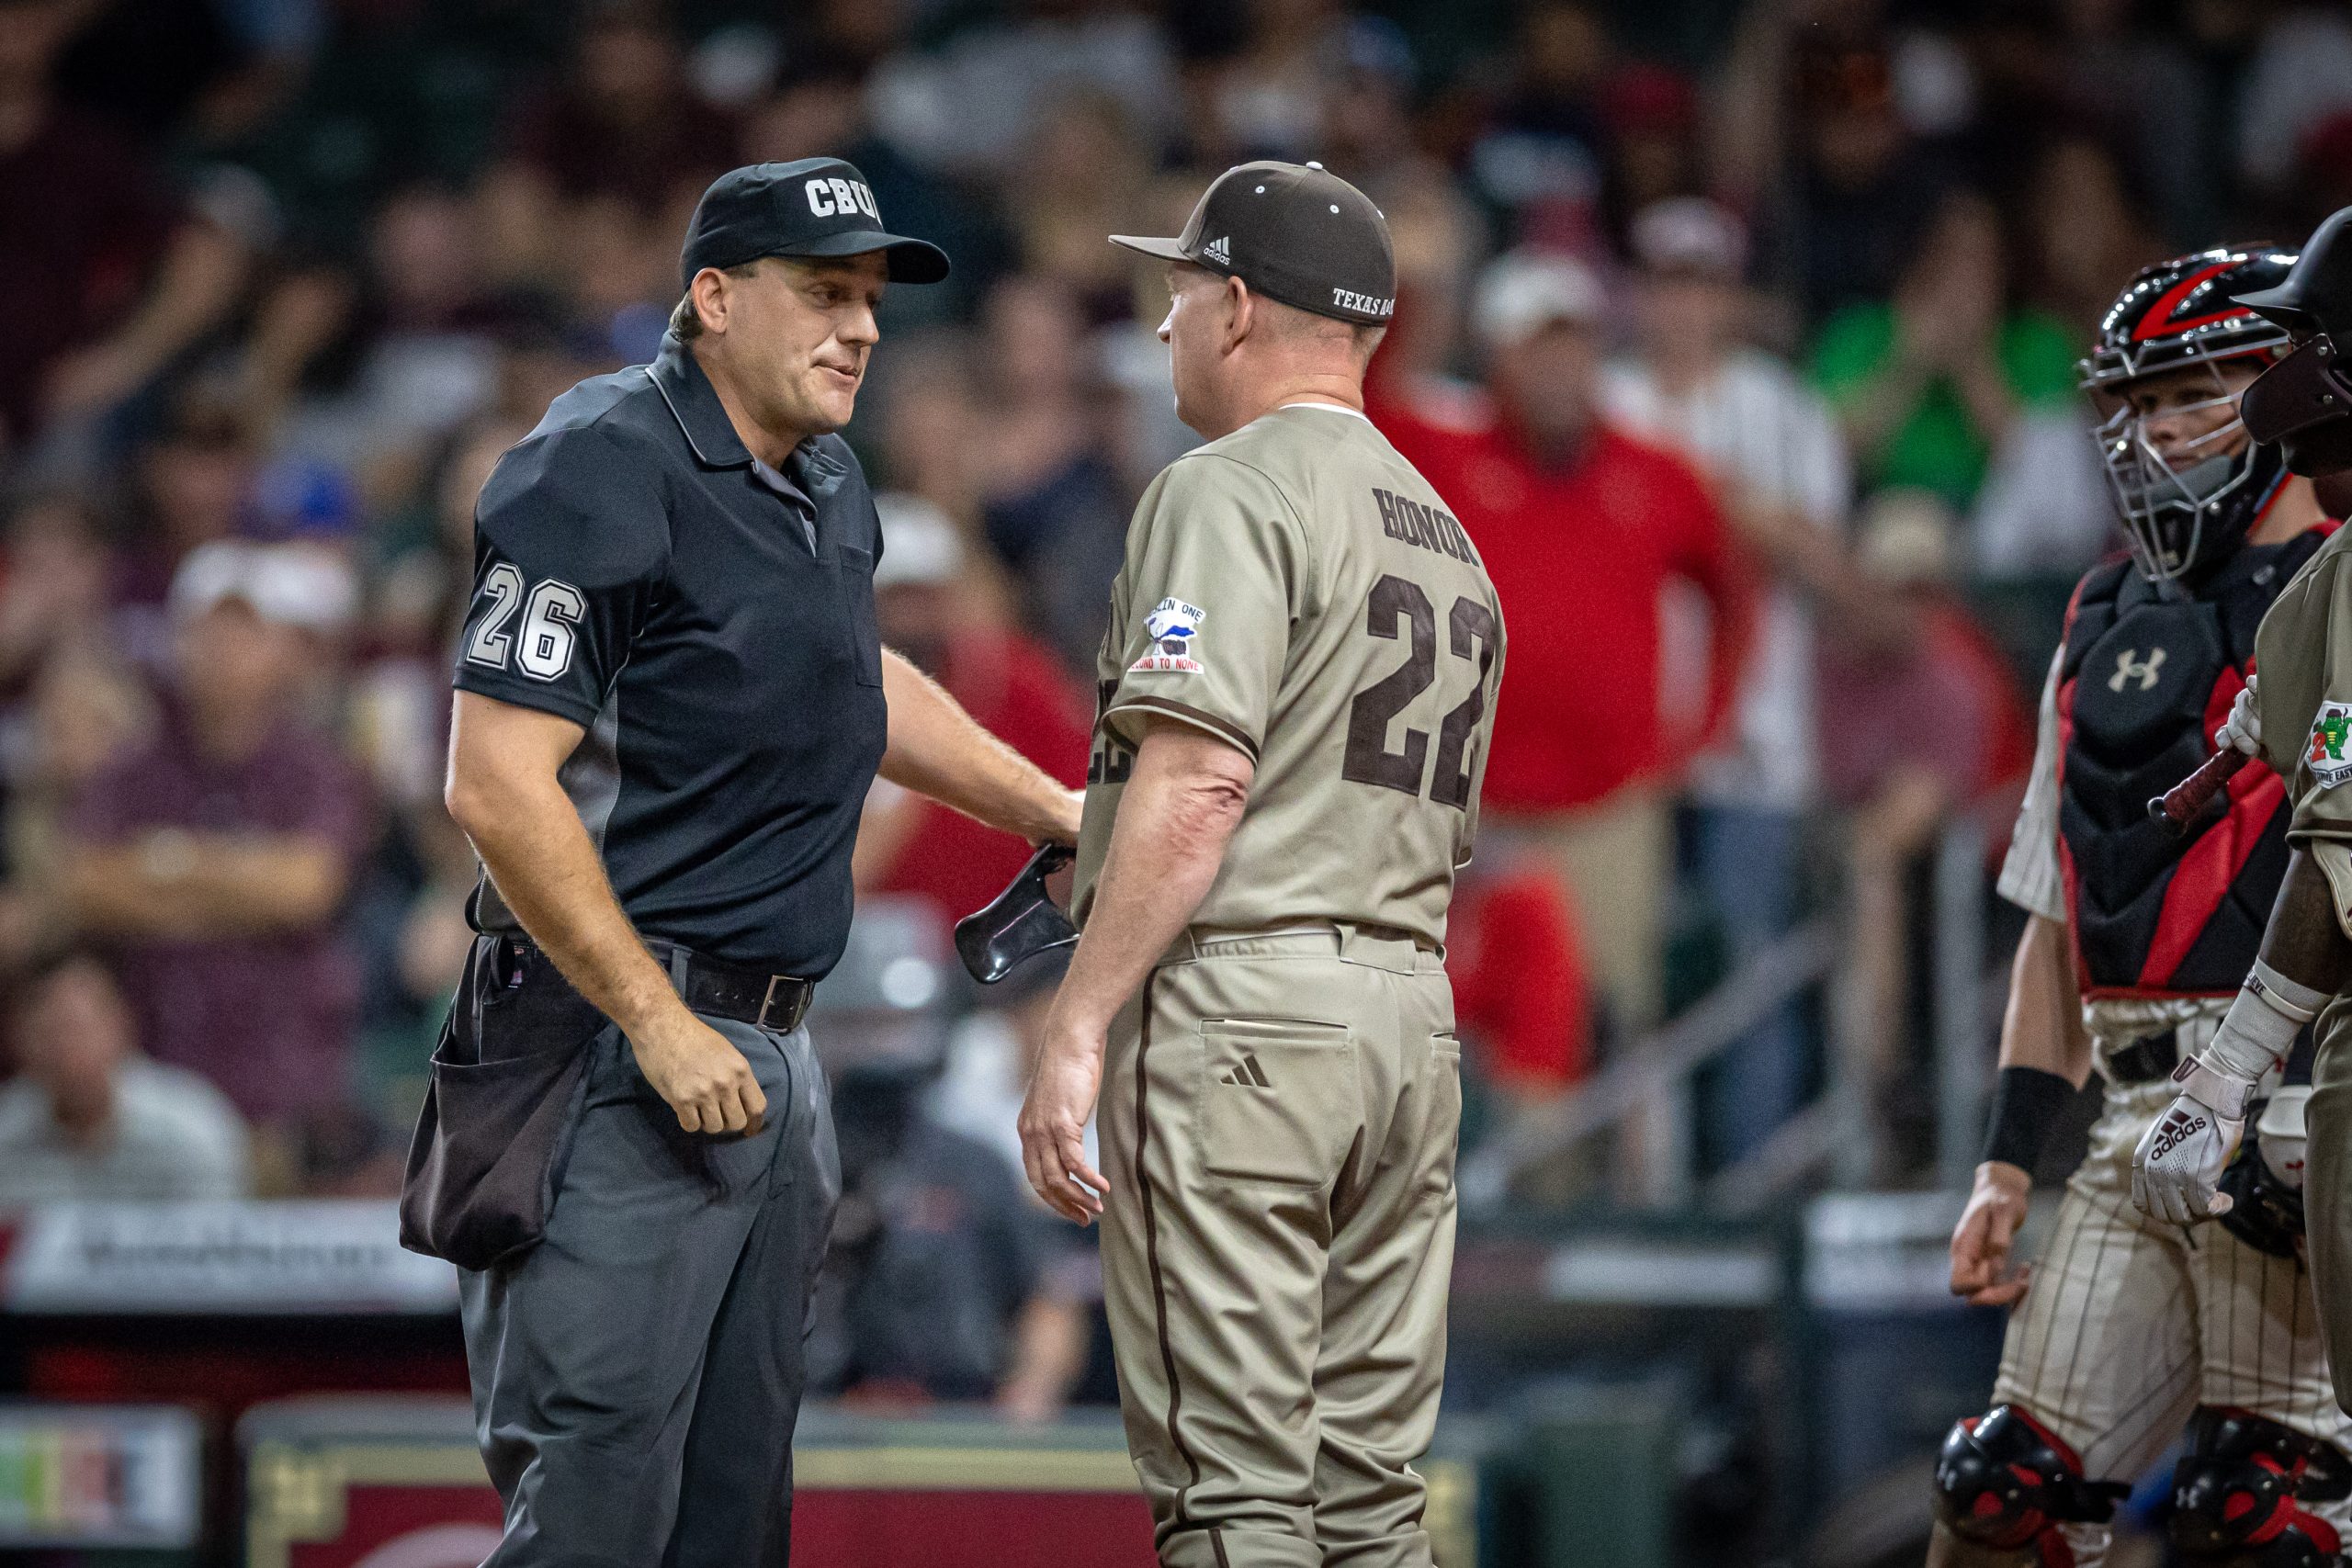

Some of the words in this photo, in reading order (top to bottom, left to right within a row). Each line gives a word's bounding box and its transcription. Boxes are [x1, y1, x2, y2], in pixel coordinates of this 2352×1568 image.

[805, 177, 883, 226] CBU
[1204, 247, 1230, 265] adidas
[1333, 288, 1382, 315] TEXAS
[1372, 487, 1480, 568] HONOR
[466, 562, 588, 682] 26
[1182, 604, 1204, 623] ONE
[1159, 658, 1170, 670] TO
[1175, 658, 1199, 671] NONE
[1341, 573, 1497, 813] 22
[2311, 732, 2326, 762] 2
[2151, 1116, 2207, 1161] adidas
